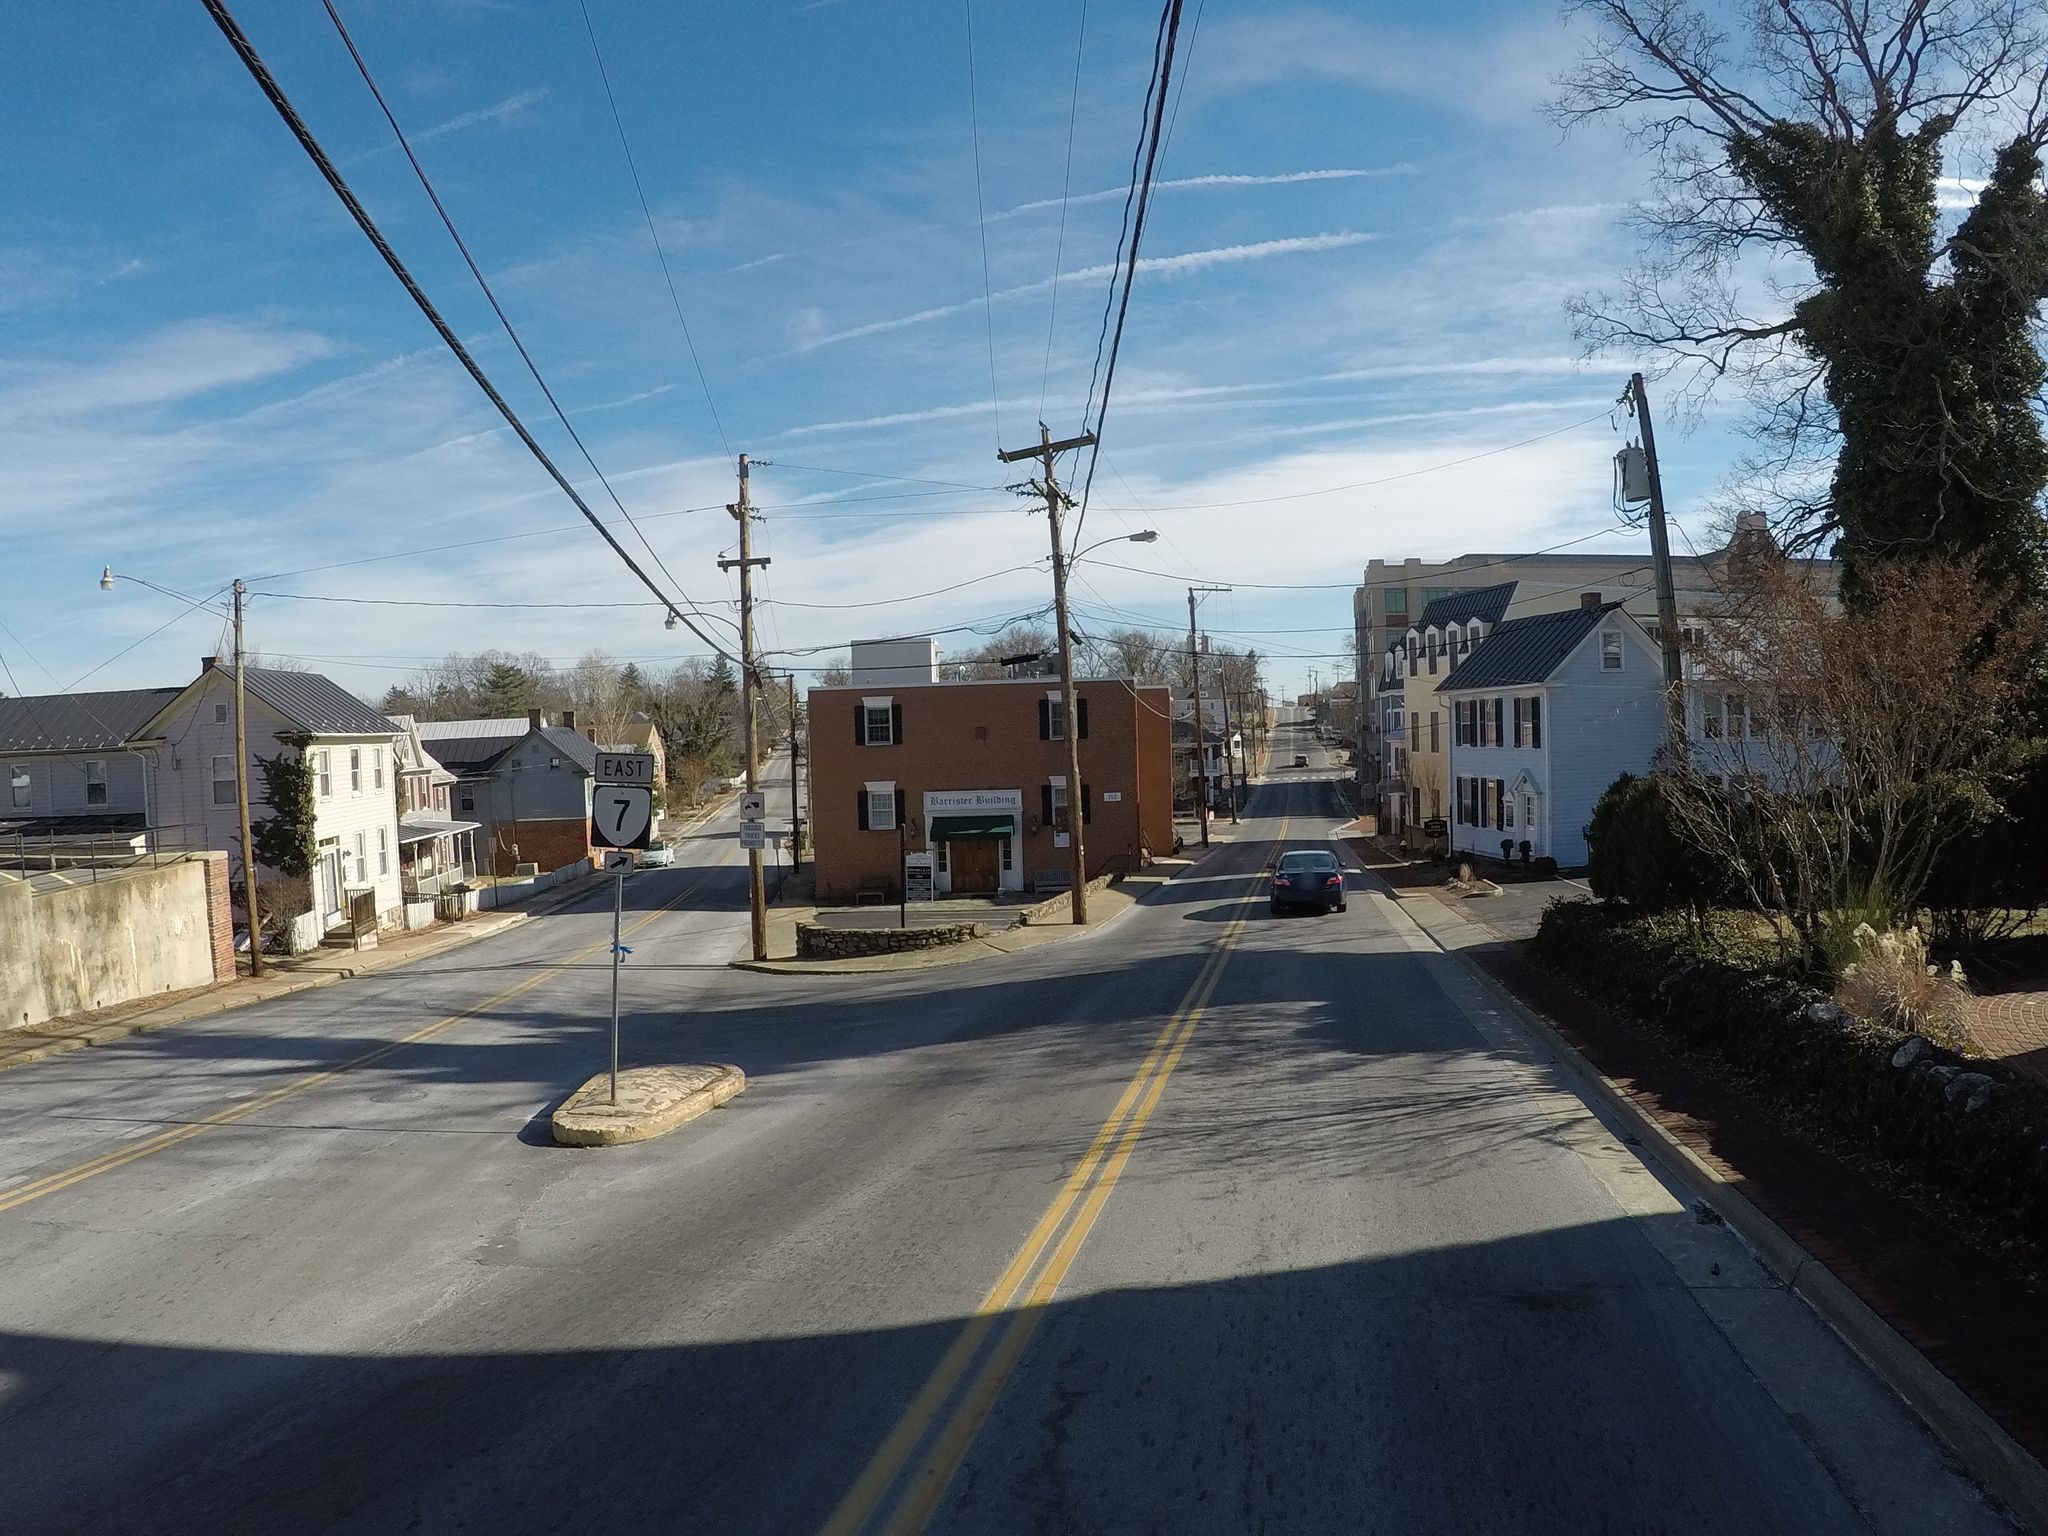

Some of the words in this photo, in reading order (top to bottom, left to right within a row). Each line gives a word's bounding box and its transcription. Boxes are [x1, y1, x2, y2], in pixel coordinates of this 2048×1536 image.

[604, 760, 644, 777] EAST
[930, 796, 972, 806] Barrister
[976, 795, 1017, 806] Building
[613, 799, 631, 832] 7
